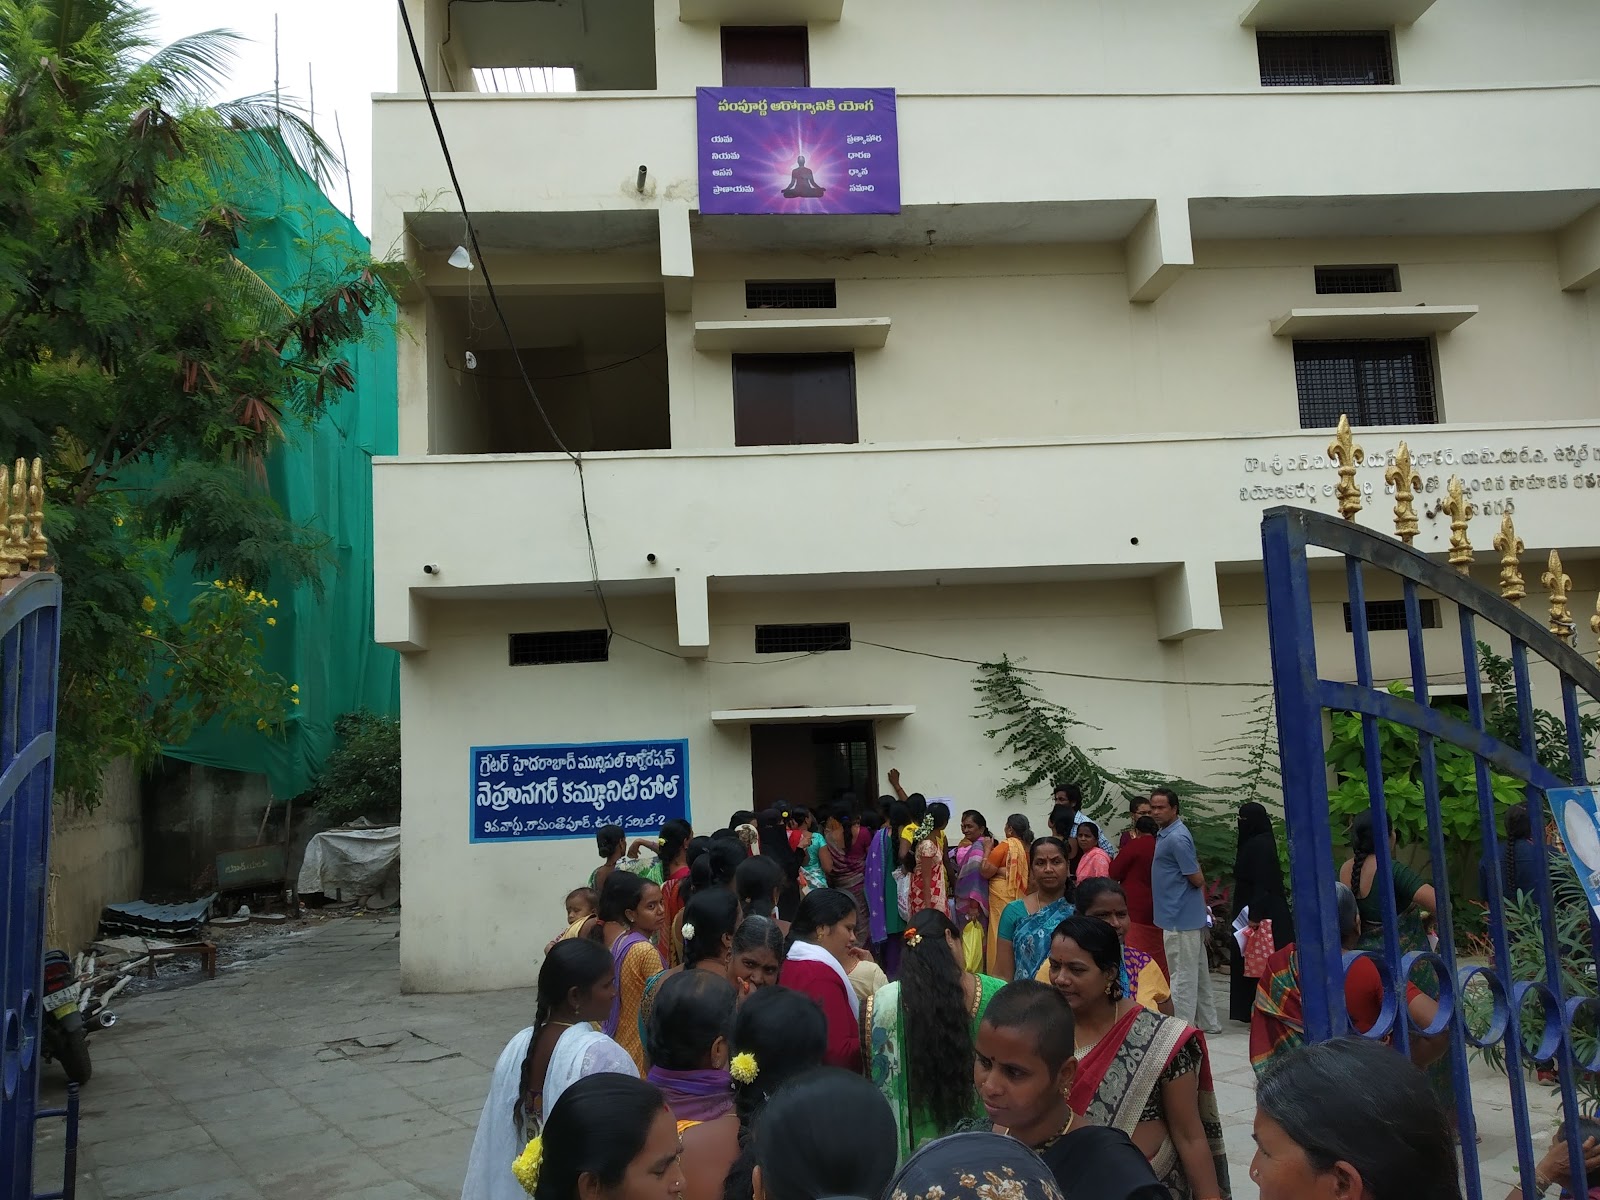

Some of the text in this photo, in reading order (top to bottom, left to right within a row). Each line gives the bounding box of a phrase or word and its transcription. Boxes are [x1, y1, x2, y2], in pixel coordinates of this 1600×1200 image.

[718, 99, 768, 116] సంపూర్ణ
[838, 99, 874, 111] యోగ
[711, 135, 733, 143] యమ
[711, 152, 740, 160] నియమ
[712, 168, 733, 176] ఆసన
